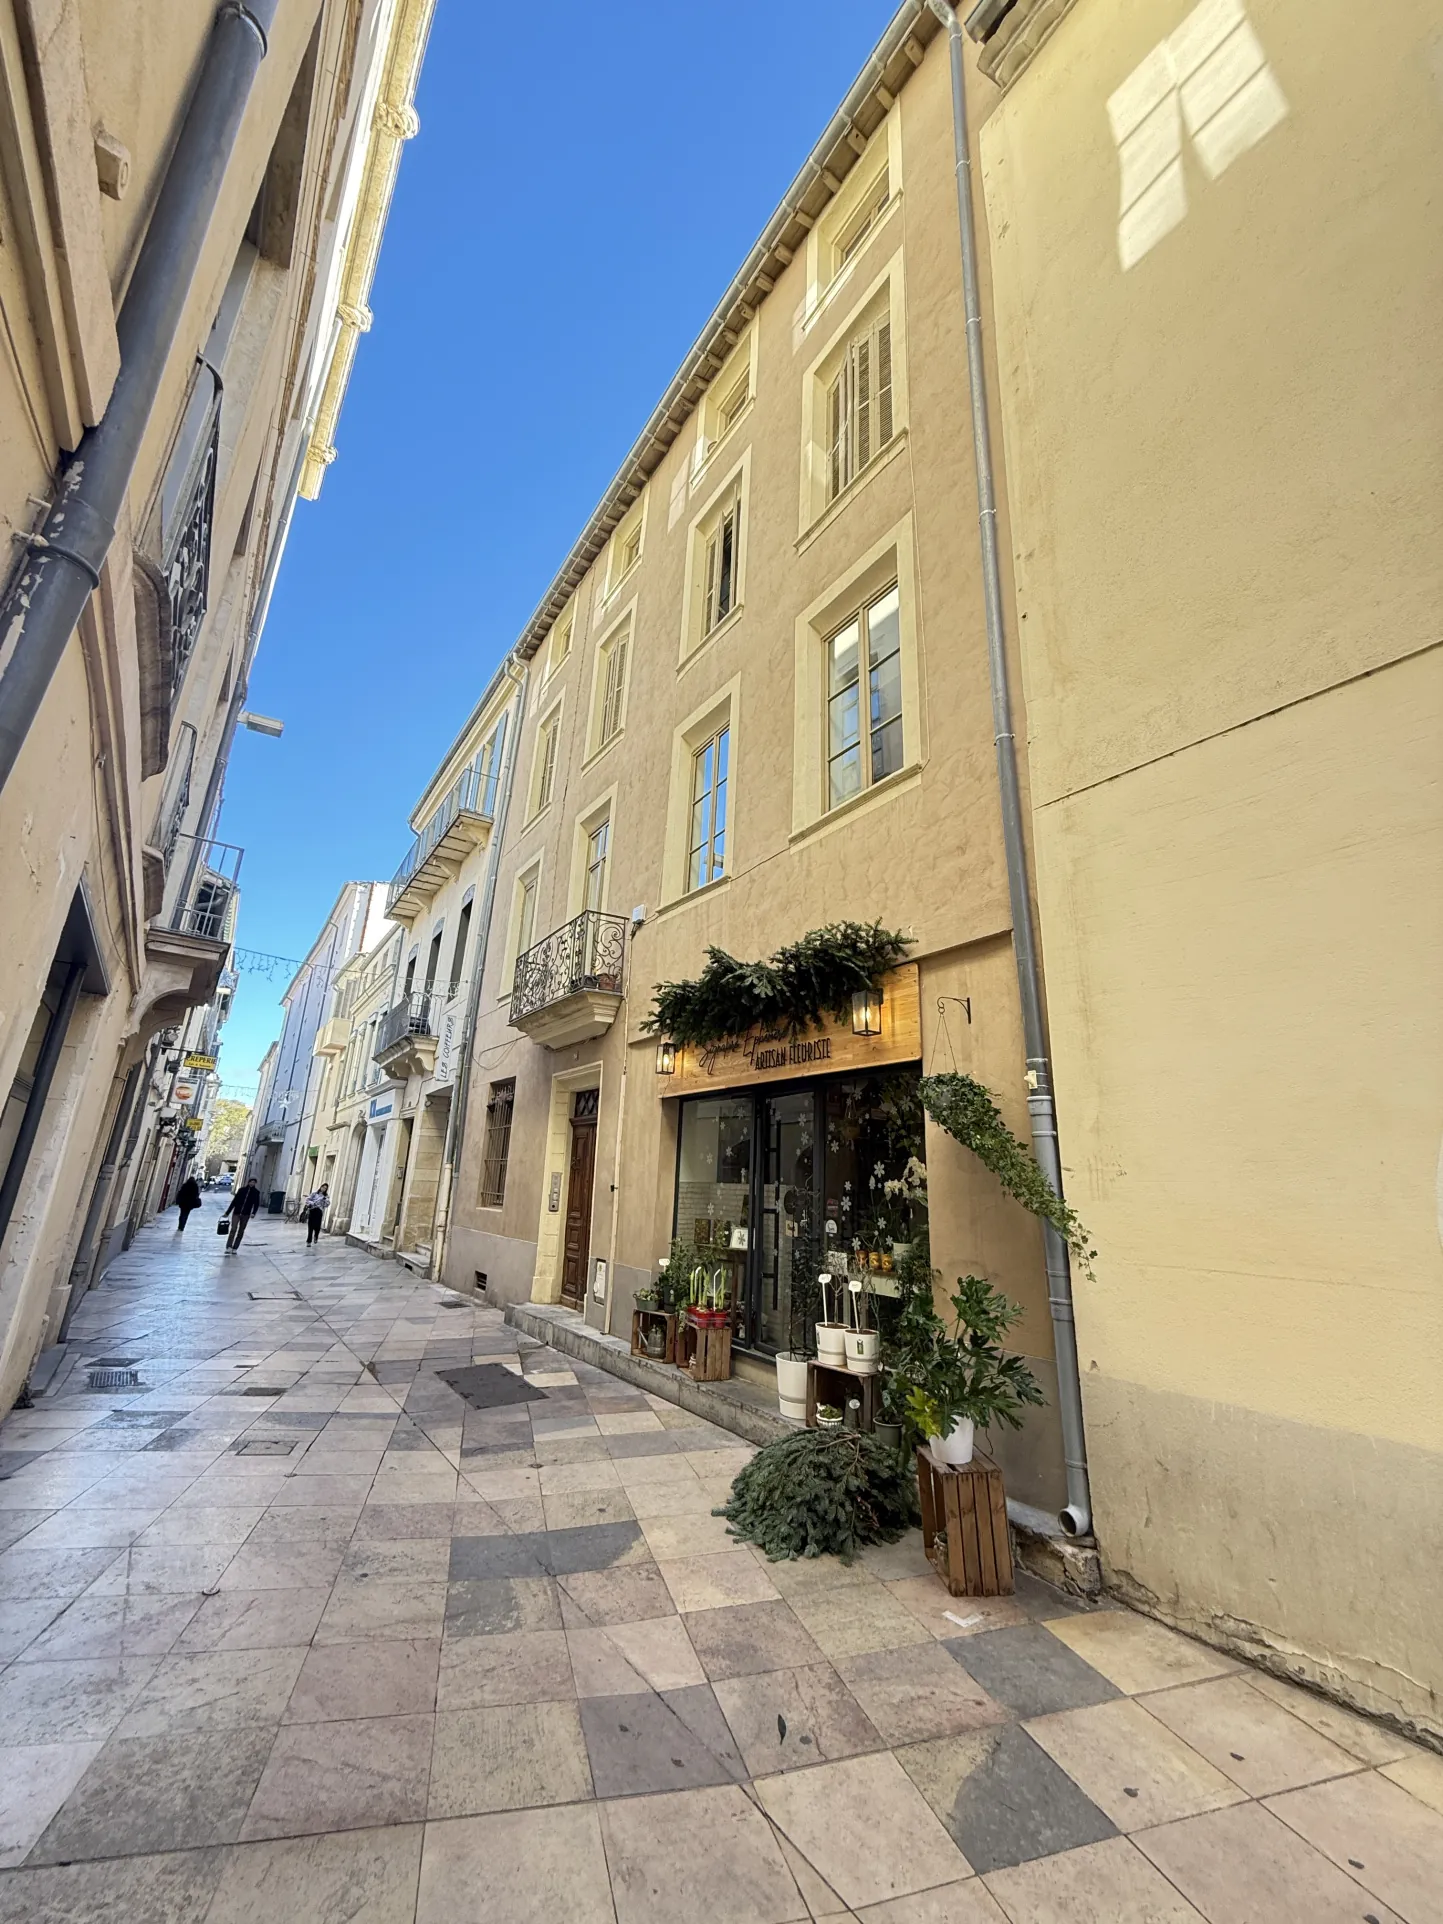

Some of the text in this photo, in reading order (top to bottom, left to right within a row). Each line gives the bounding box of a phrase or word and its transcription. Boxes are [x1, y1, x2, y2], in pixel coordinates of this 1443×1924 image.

[440, 1016, 455, 1079] LES COIFFEURS
[755, 1037, 831, 1070] ARTISAN FLEURISTE
